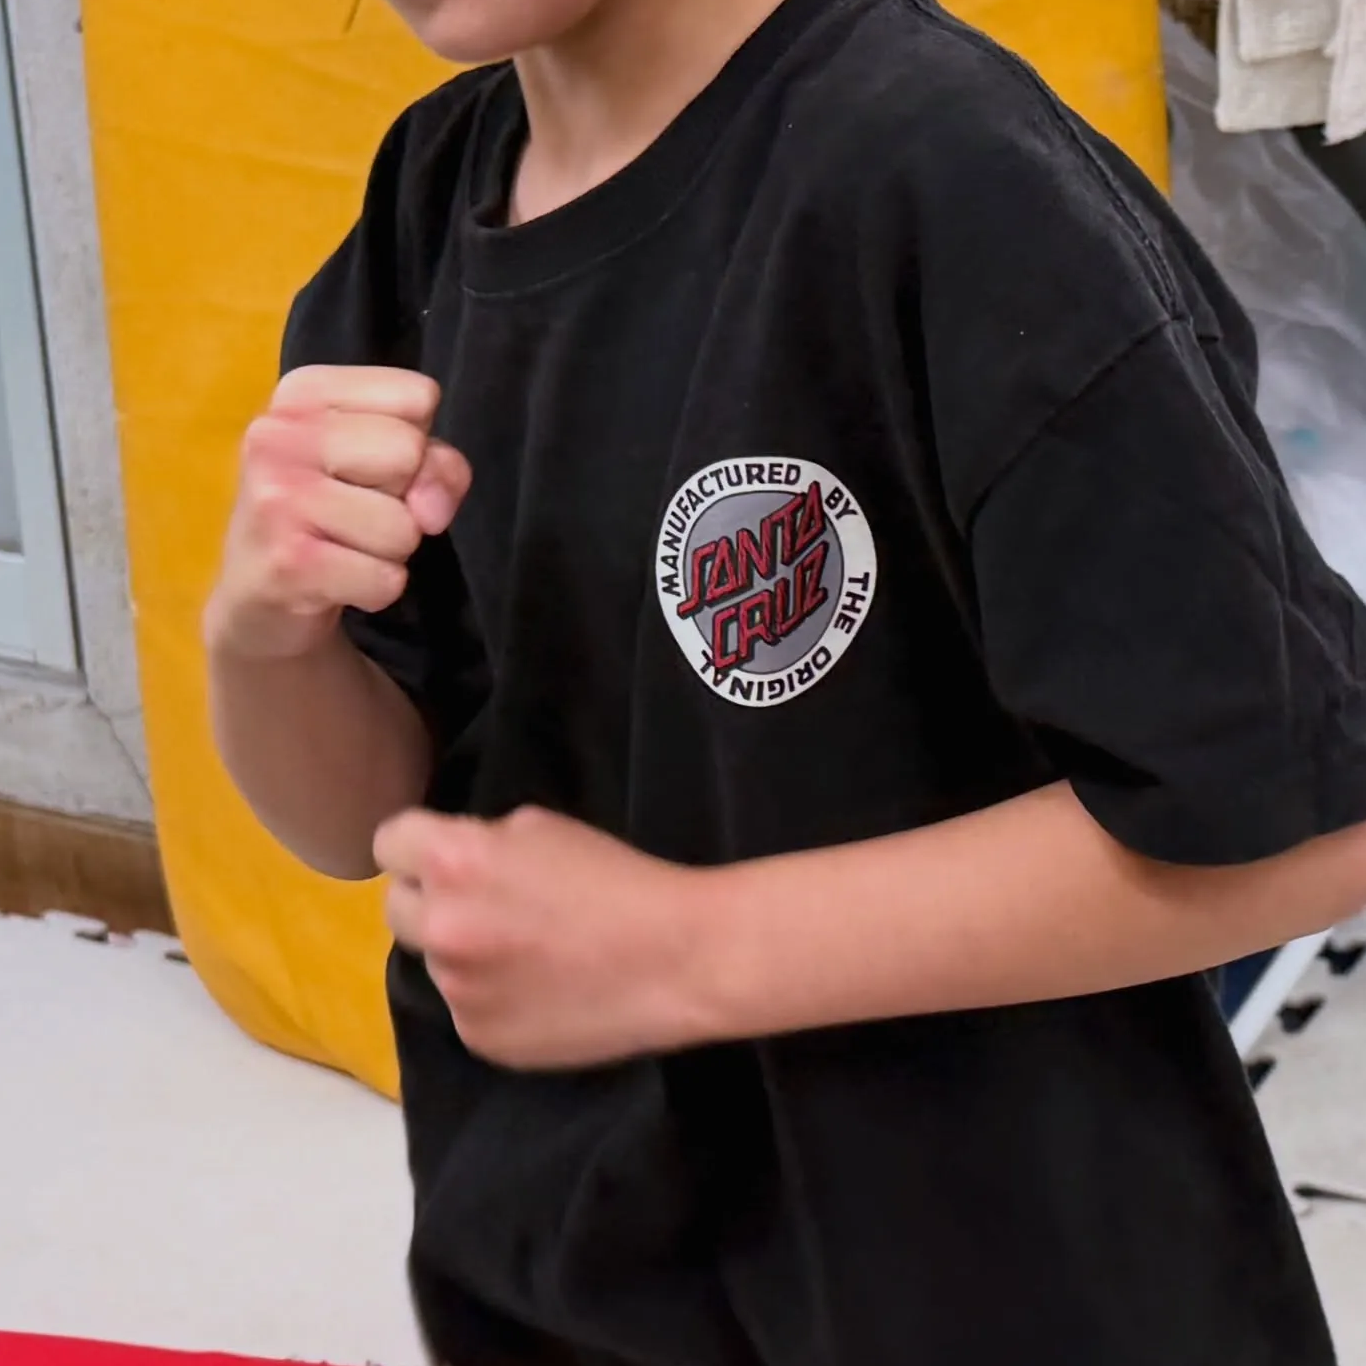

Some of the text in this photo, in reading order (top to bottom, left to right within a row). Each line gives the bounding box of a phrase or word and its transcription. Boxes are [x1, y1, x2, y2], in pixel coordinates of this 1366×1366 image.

[660, 463, 801, 597] MANUFACTURED
[676, 480, 826, 619] SANTA
[824, 486, 857, 520] BY
[712, 541, 829, 672] CRUZ
[833, 571, 870, 634] THE
